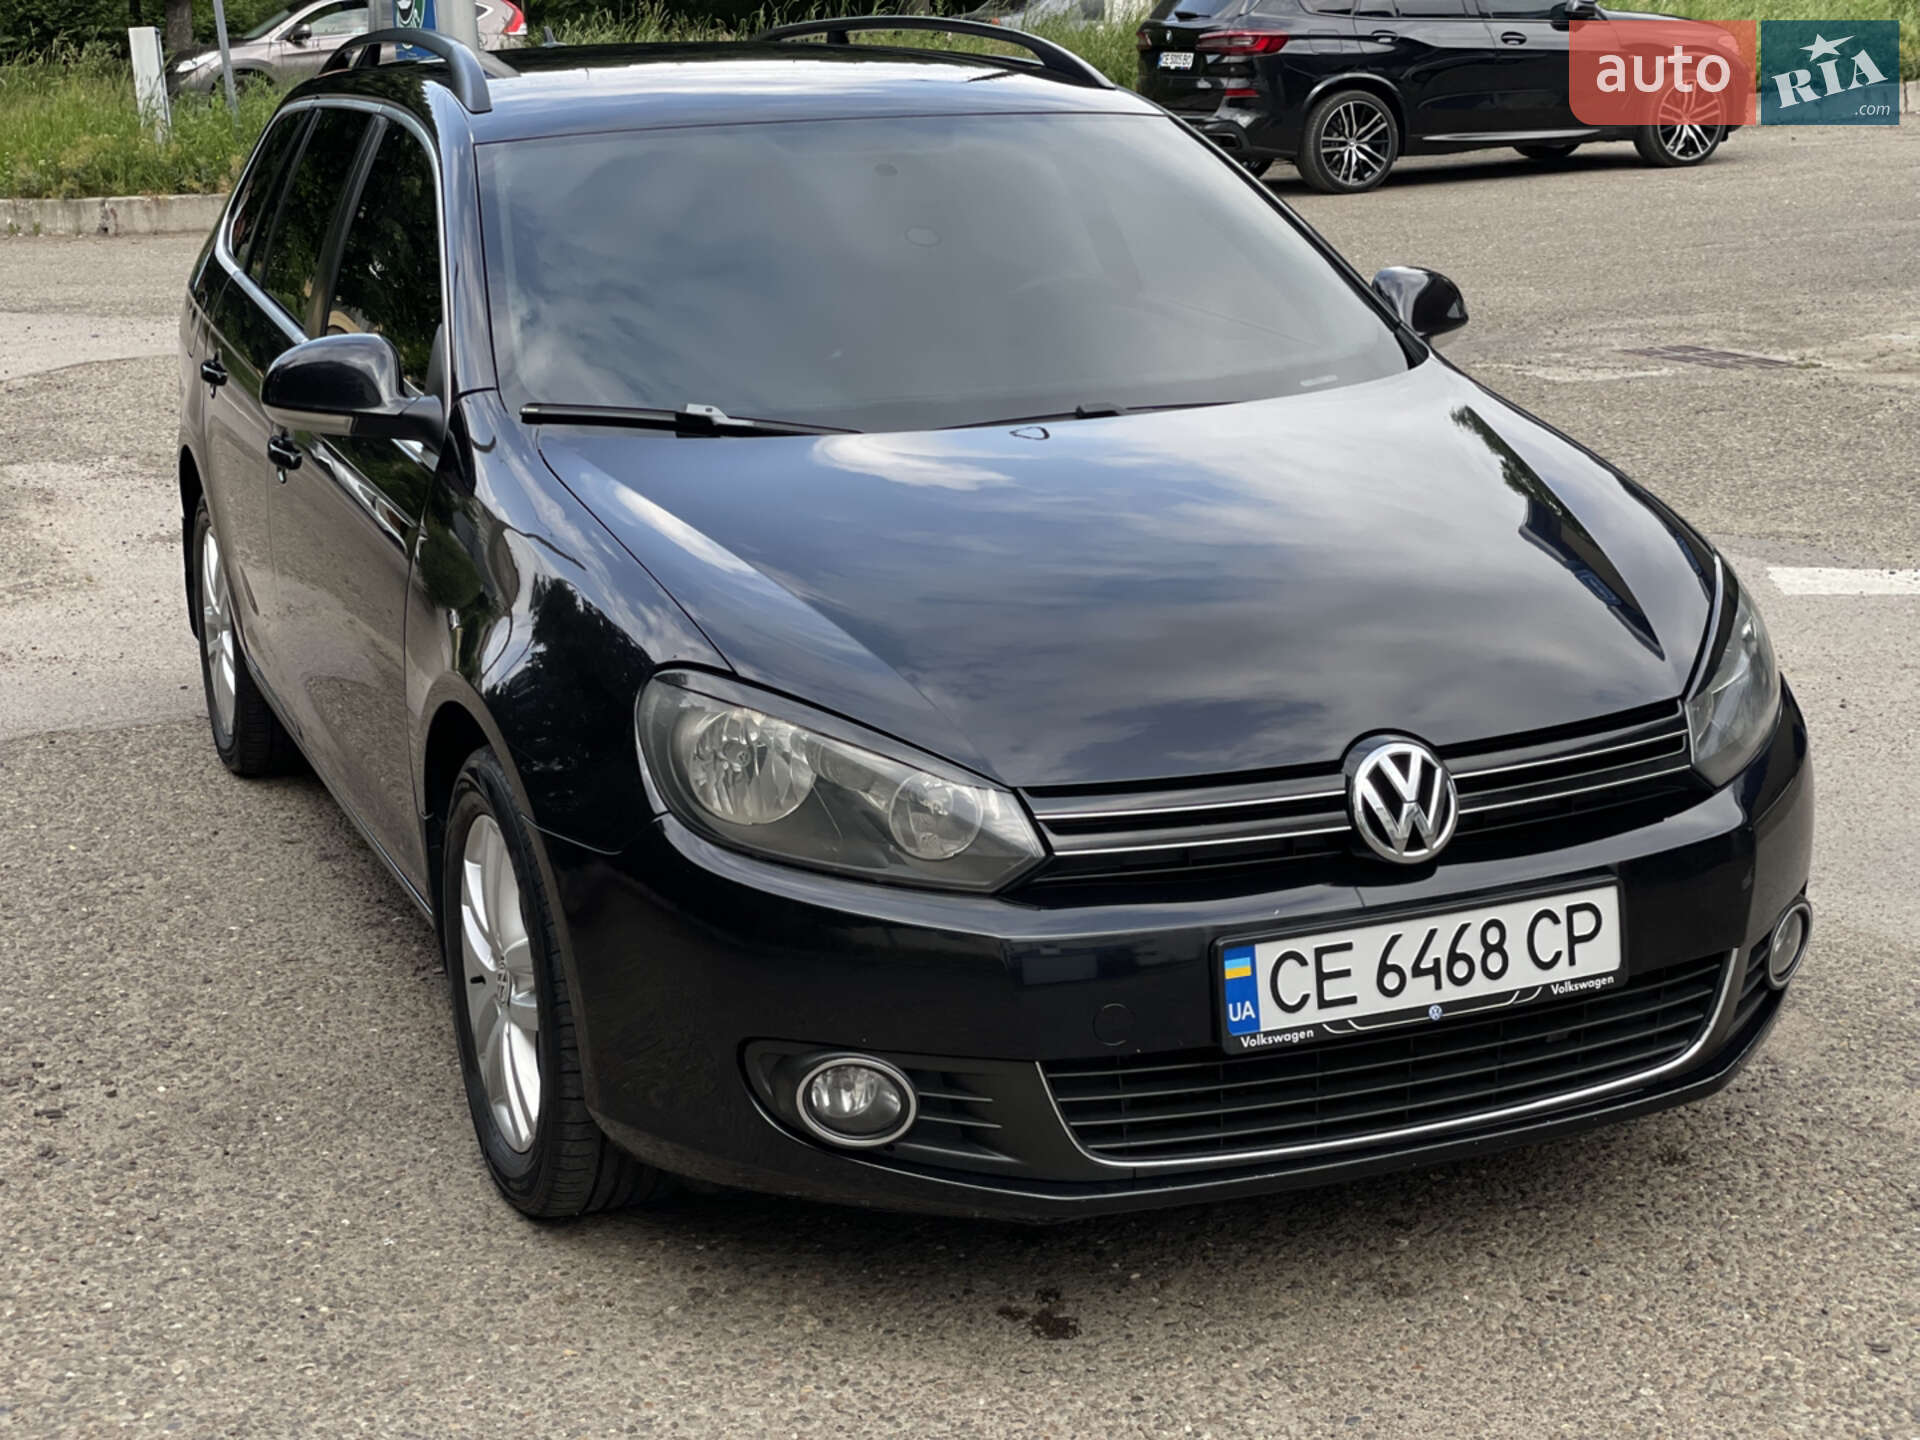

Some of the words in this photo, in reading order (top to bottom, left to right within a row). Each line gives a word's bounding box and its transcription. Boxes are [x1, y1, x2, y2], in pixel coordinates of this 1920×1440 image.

[1270, 942, 1358, 1013] CE
[1376, 918, 1509, 998] 6468
[1527, 902, 1602, 970] CP
[1551, 976, 1614, 995] Volkswagen
[1228, 1000, 1256, 1022] UA
[1240, 1030, 1314, 1048] Volkswagen
